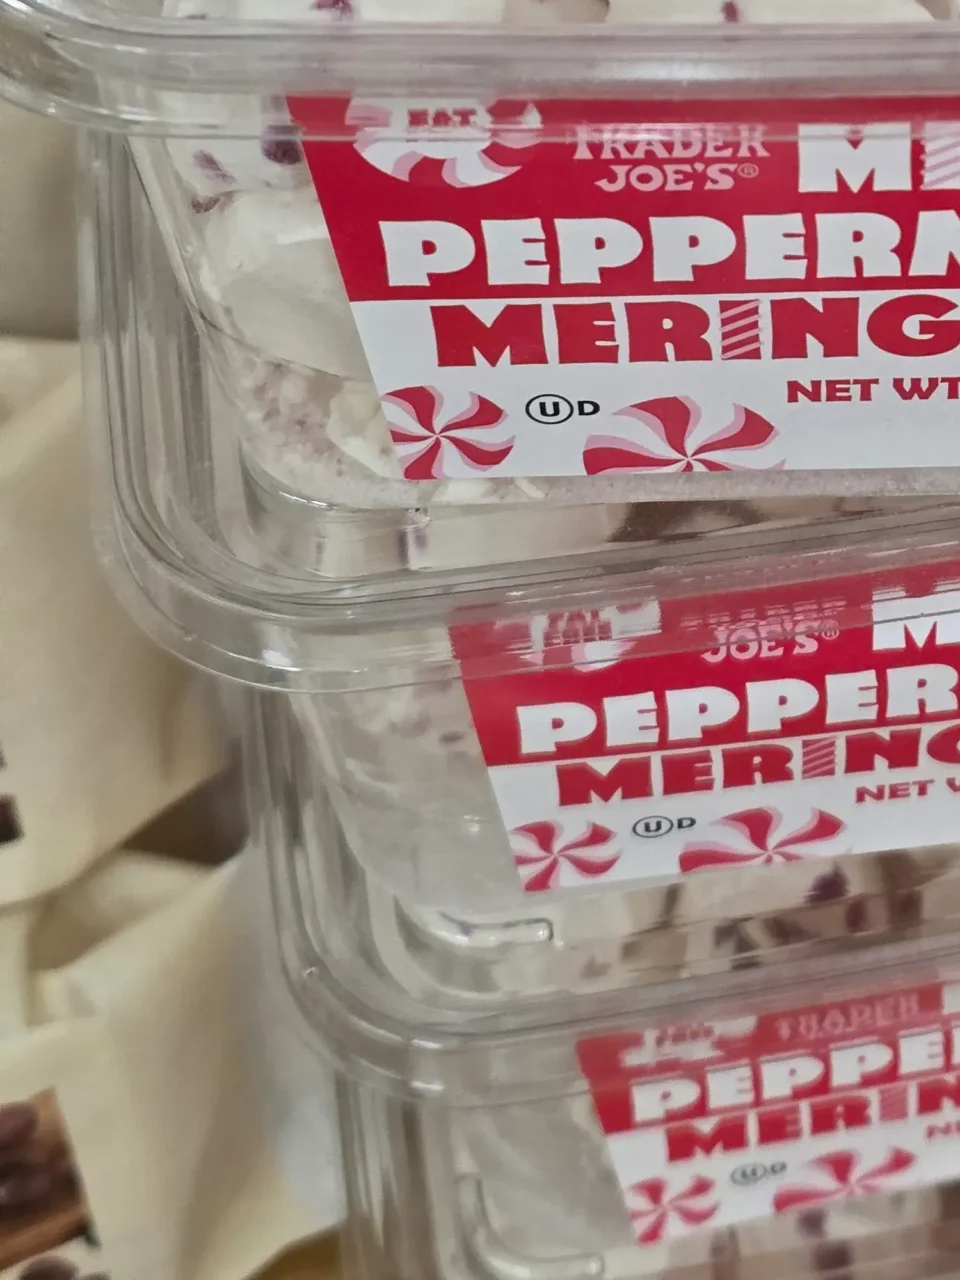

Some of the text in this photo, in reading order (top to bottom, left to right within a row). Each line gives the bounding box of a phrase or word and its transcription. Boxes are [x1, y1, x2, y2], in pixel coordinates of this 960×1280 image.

[572, 122, 771, 160] TRADER
[786, 377, 880, 404] NET
[855, 776, 935, 805] NET
